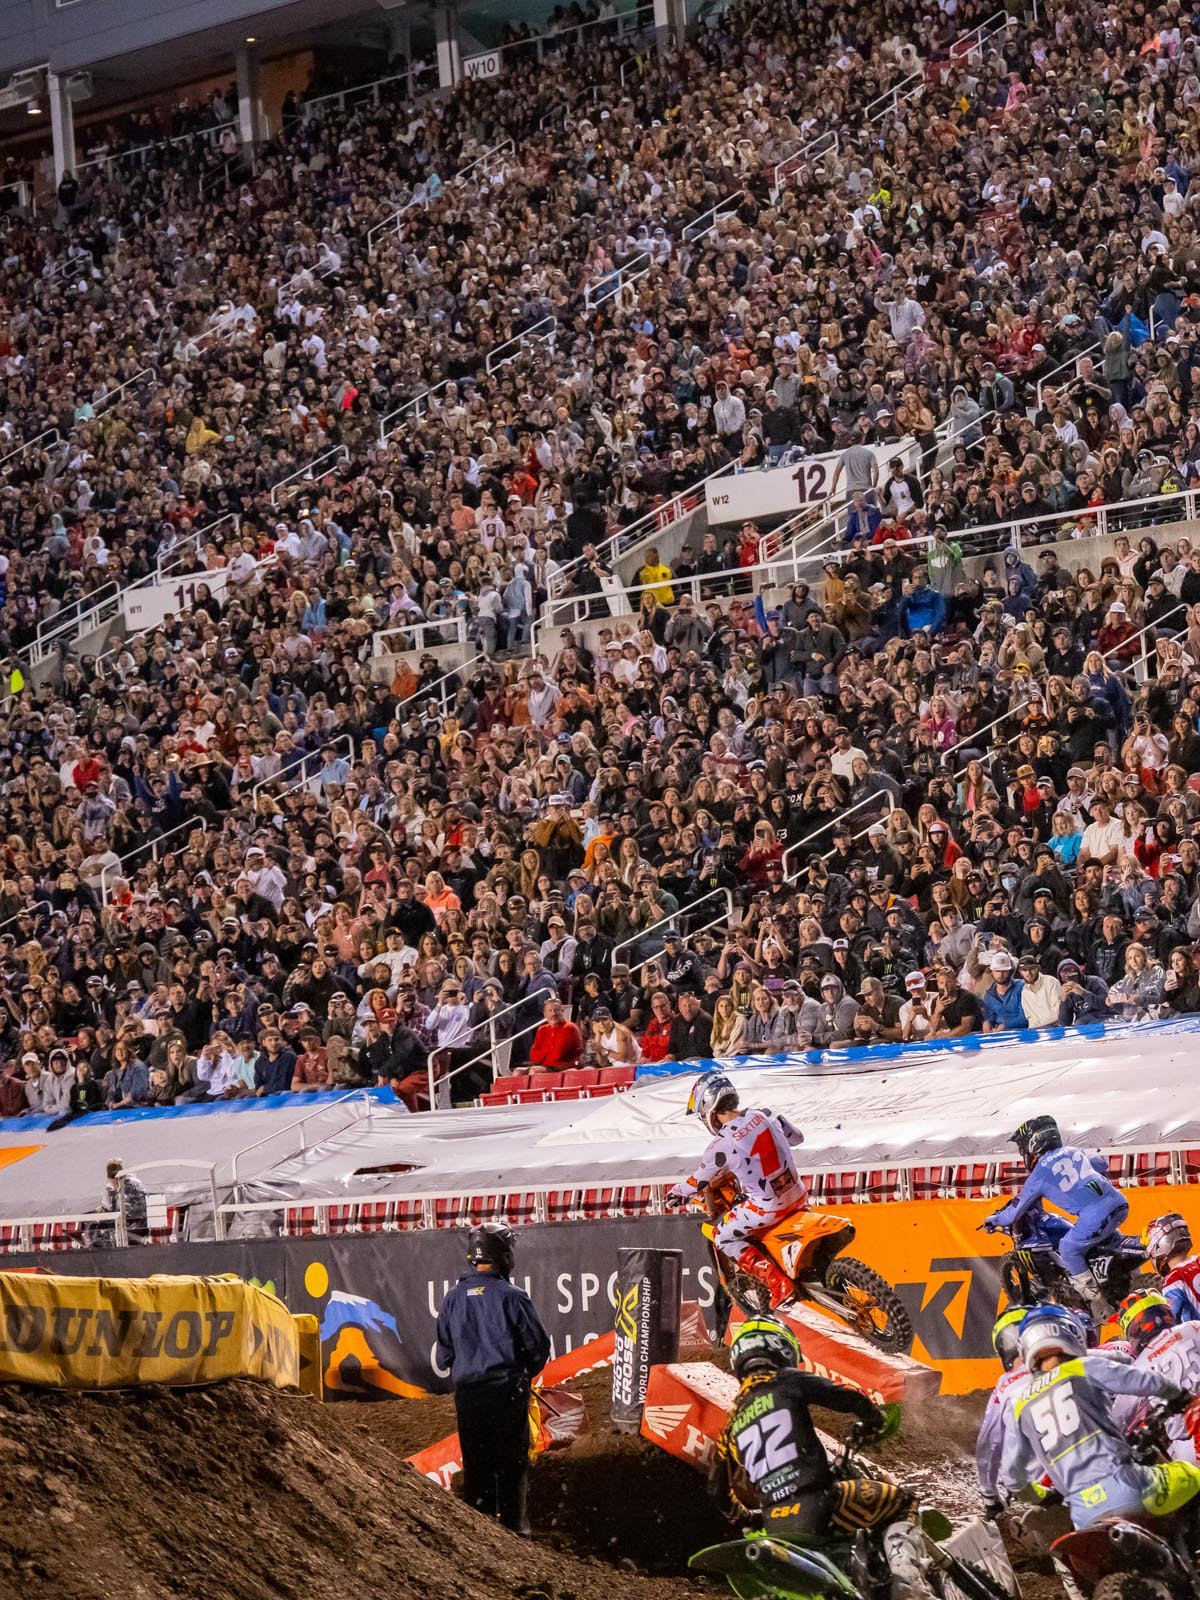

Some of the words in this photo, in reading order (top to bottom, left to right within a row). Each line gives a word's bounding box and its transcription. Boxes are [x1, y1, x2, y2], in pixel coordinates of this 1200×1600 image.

[468, 58, 496, 77] W10
[712, 494, 730, 506] W12
[792, 463, 828, 503] 12
[732, 1113, 765, 1142] SEXTON
[750, 1127, 782, 1177] 1
[1051, 1150, 1096, 1193] 32
[1121, 1247, 1147, 1255] DUNLO
[5, 1305, 235, 1359] DUNLOP
[640, 1276, 652, 1362] CHAMPIONSHIP
[622, 1336, 634, 1406] CROSS
[638, 1365, 649, 1404] WORLD
[1029, 1382, 1081, 1453] 56
[736, 1408, 799, 1484] 22
